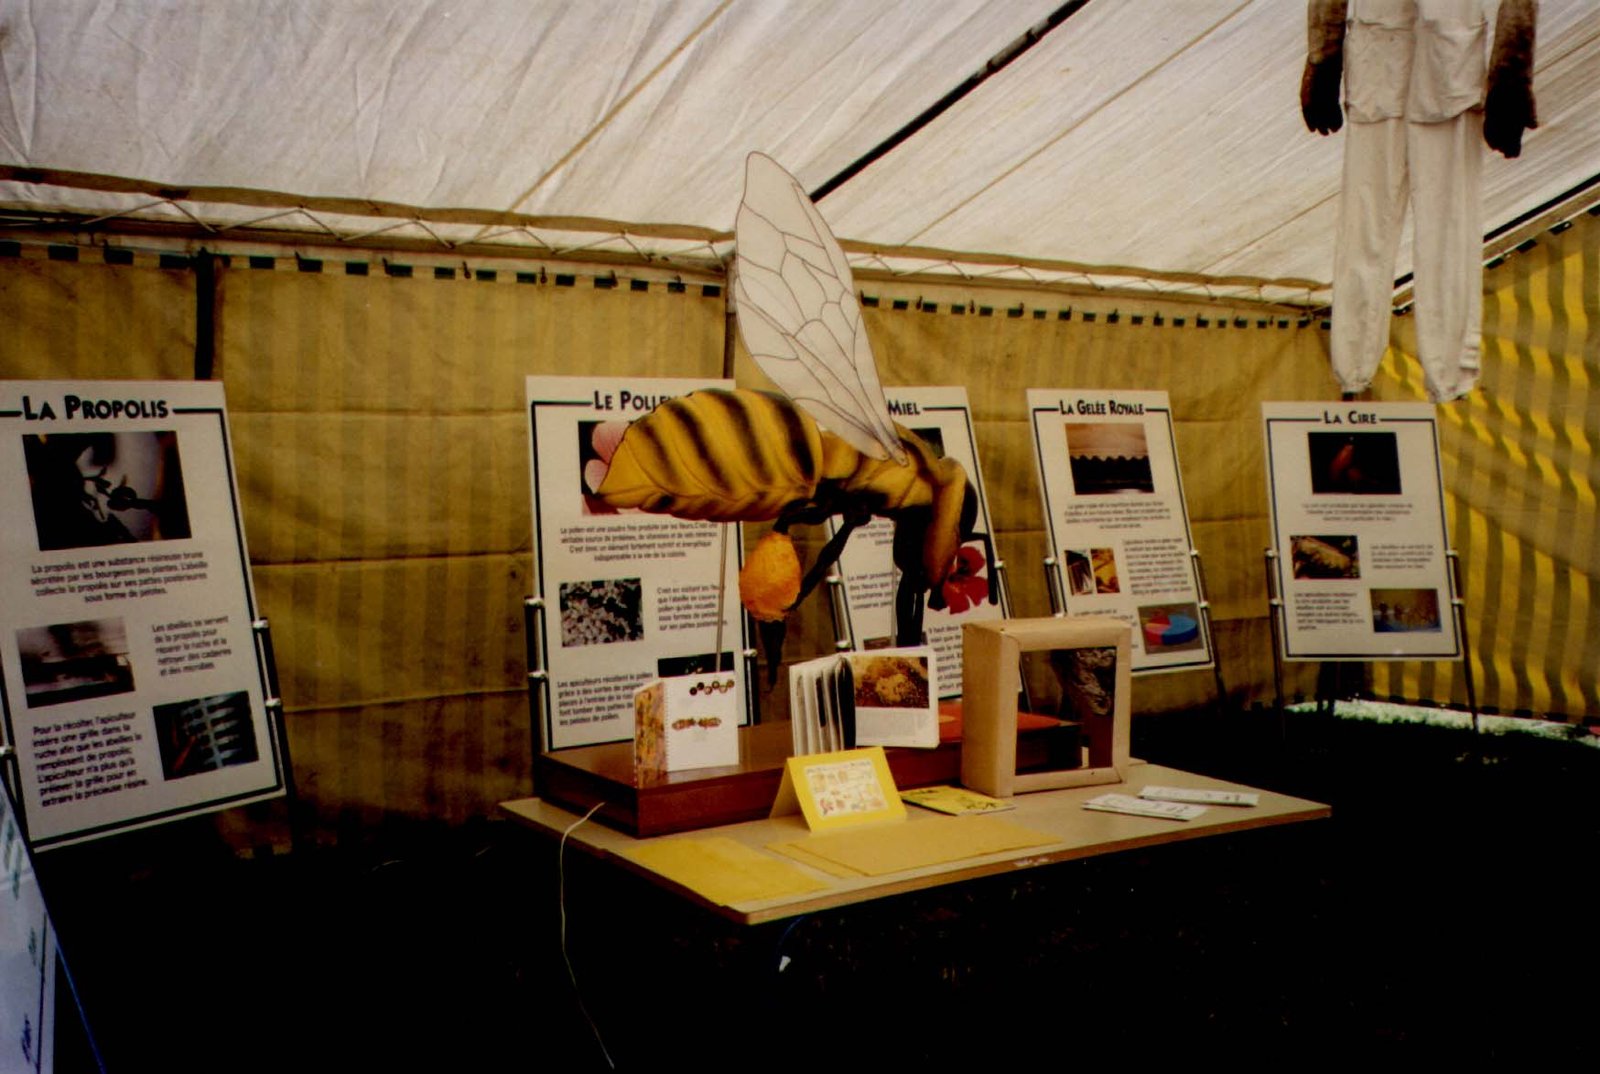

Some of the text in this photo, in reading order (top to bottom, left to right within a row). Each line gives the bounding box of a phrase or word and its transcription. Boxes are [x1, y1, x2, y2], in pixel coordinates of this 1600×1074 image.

[22, 394, 169, 421] LA PROPOLIS
[594, 390, 671, 412] LE POLLE
[887, 400, 920, 415] MIEL
[1060, 399, 1145, 415] LA GELÉE ROYALE
[1324, 410, 1377, 424] LA CIRE
